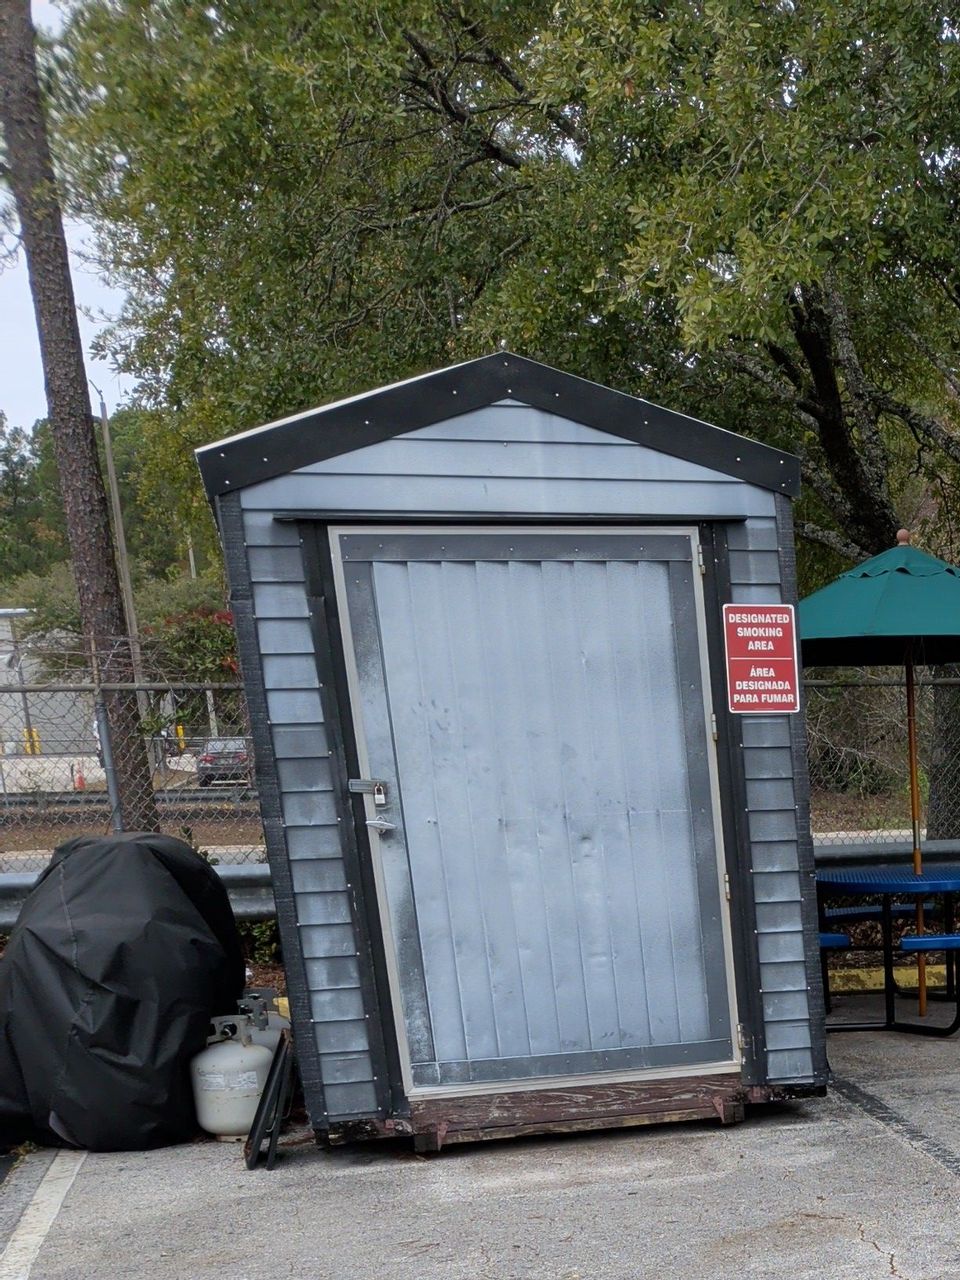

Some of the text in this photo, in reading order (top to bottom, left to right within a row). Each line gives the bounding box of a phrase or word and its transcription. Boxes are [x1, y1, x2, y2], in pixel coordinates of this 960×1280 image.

[728, 613, 790, 624] DESIGNATED
[737, 627, 783, 637] SMOKING
[748, 641, 775, 651] AREA
[750, 665, 775, 677] ÁREA
[735, 681, 791, 690] DESIGNADA
[733, 694, 794, 703] PARA FUMAR
